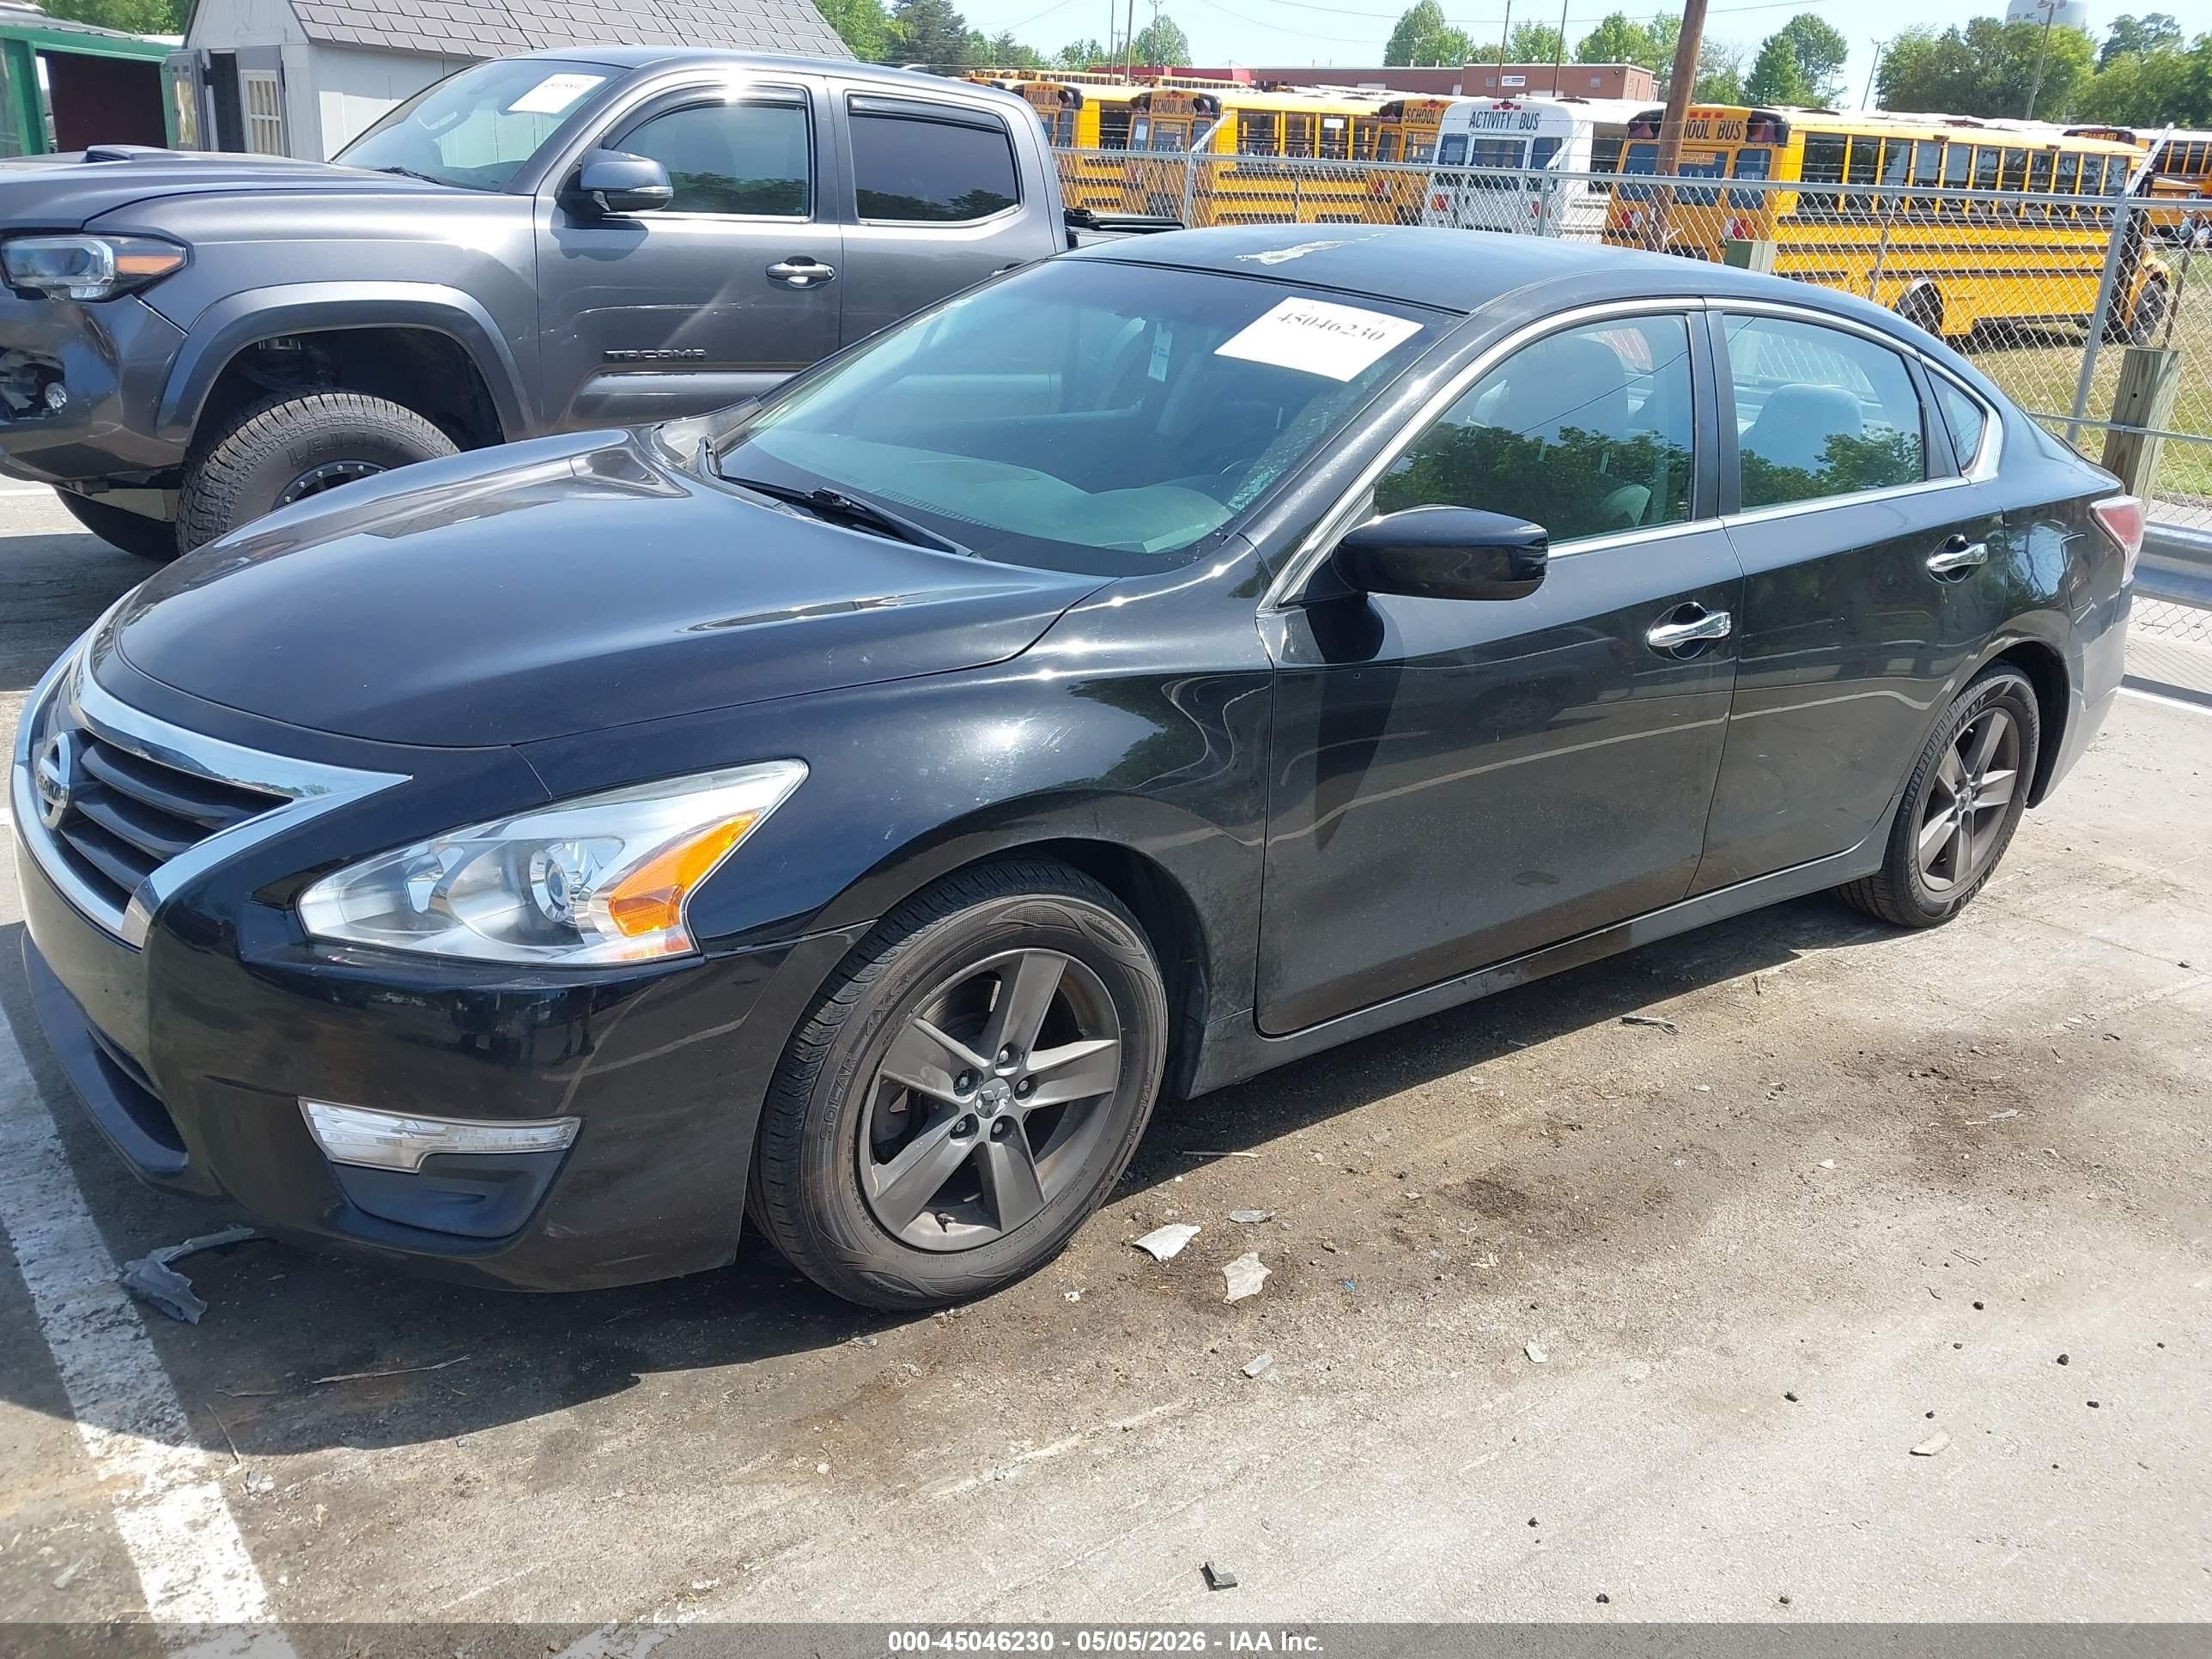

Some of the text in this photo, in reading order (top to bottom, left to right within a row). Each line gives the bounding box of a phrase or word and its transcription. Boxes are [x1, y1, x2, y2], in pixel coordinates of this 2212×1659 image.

[1025, 90, 1060, 105] SCHOOL BUS
[1153, 99, 1194, 114] SCHOOL BUS
[1406, 108, 1437, 125] SCHOOL
[1469, 111, 1540, 131] ACTIVITY BUS
[1716, 120, 1743, 140] BUS
[1277, 312, 1386, 341] 45046230
[603, 349, 708, 360] TACOMA
[819, 1056, 859, 1141] SOLAR
